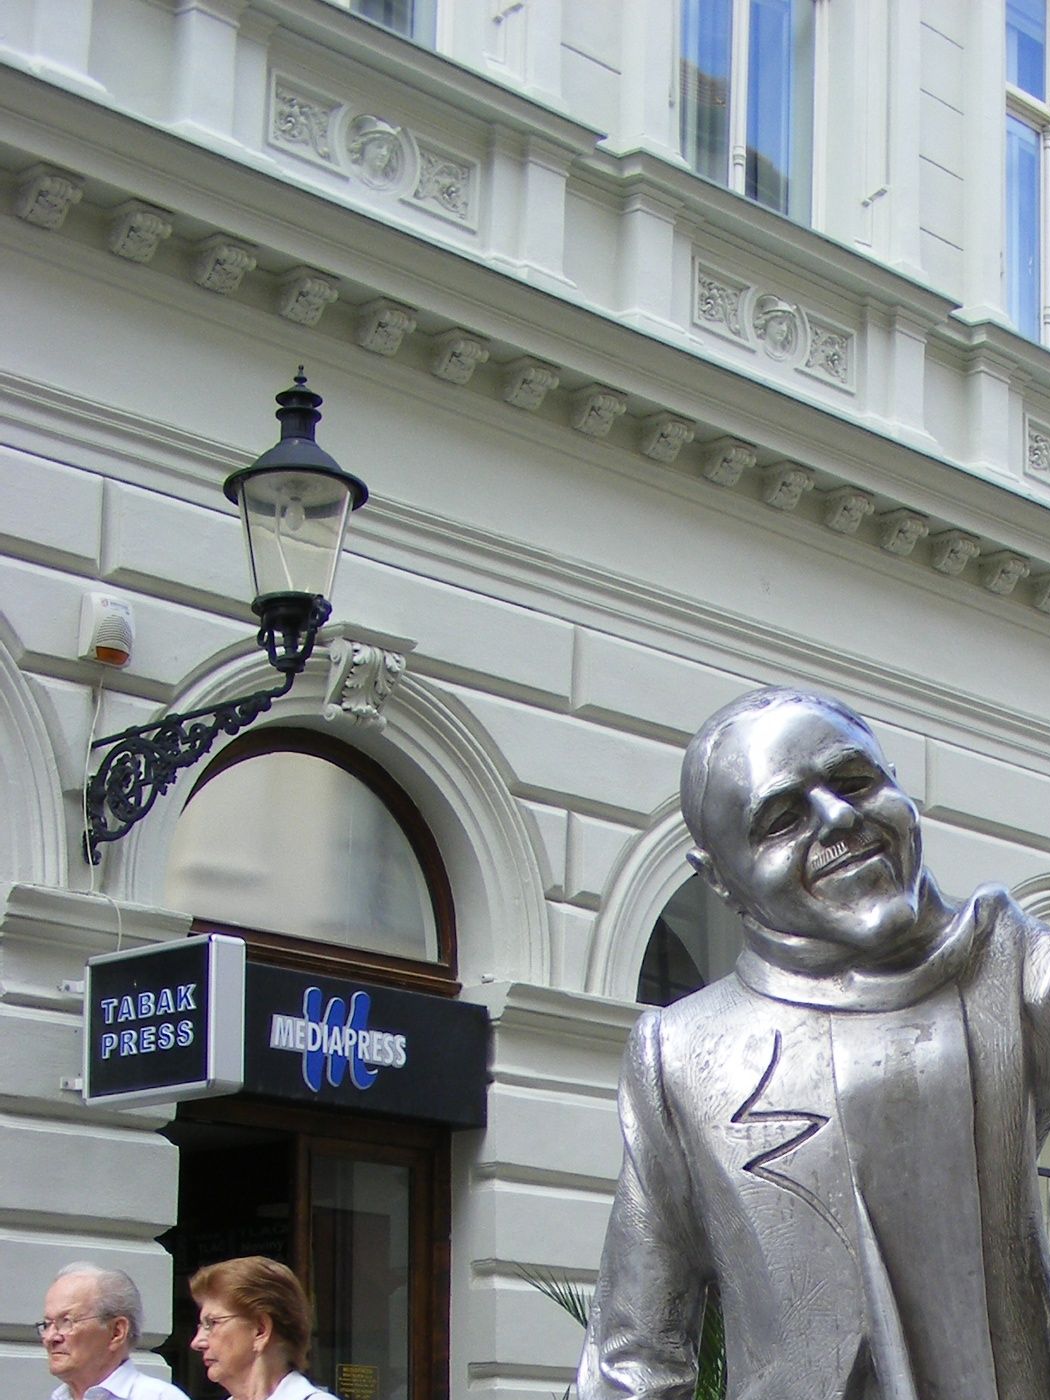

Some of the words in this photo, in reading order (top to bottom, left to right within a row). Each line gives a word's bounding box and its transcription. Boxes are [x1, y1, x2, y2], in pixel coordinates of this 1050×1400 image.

[101, 984, 197, 1024] TABAK
[102, 1020, 194, 1059] PRESS
[271, 1015, 407, 1067] MEDIAPRESS
